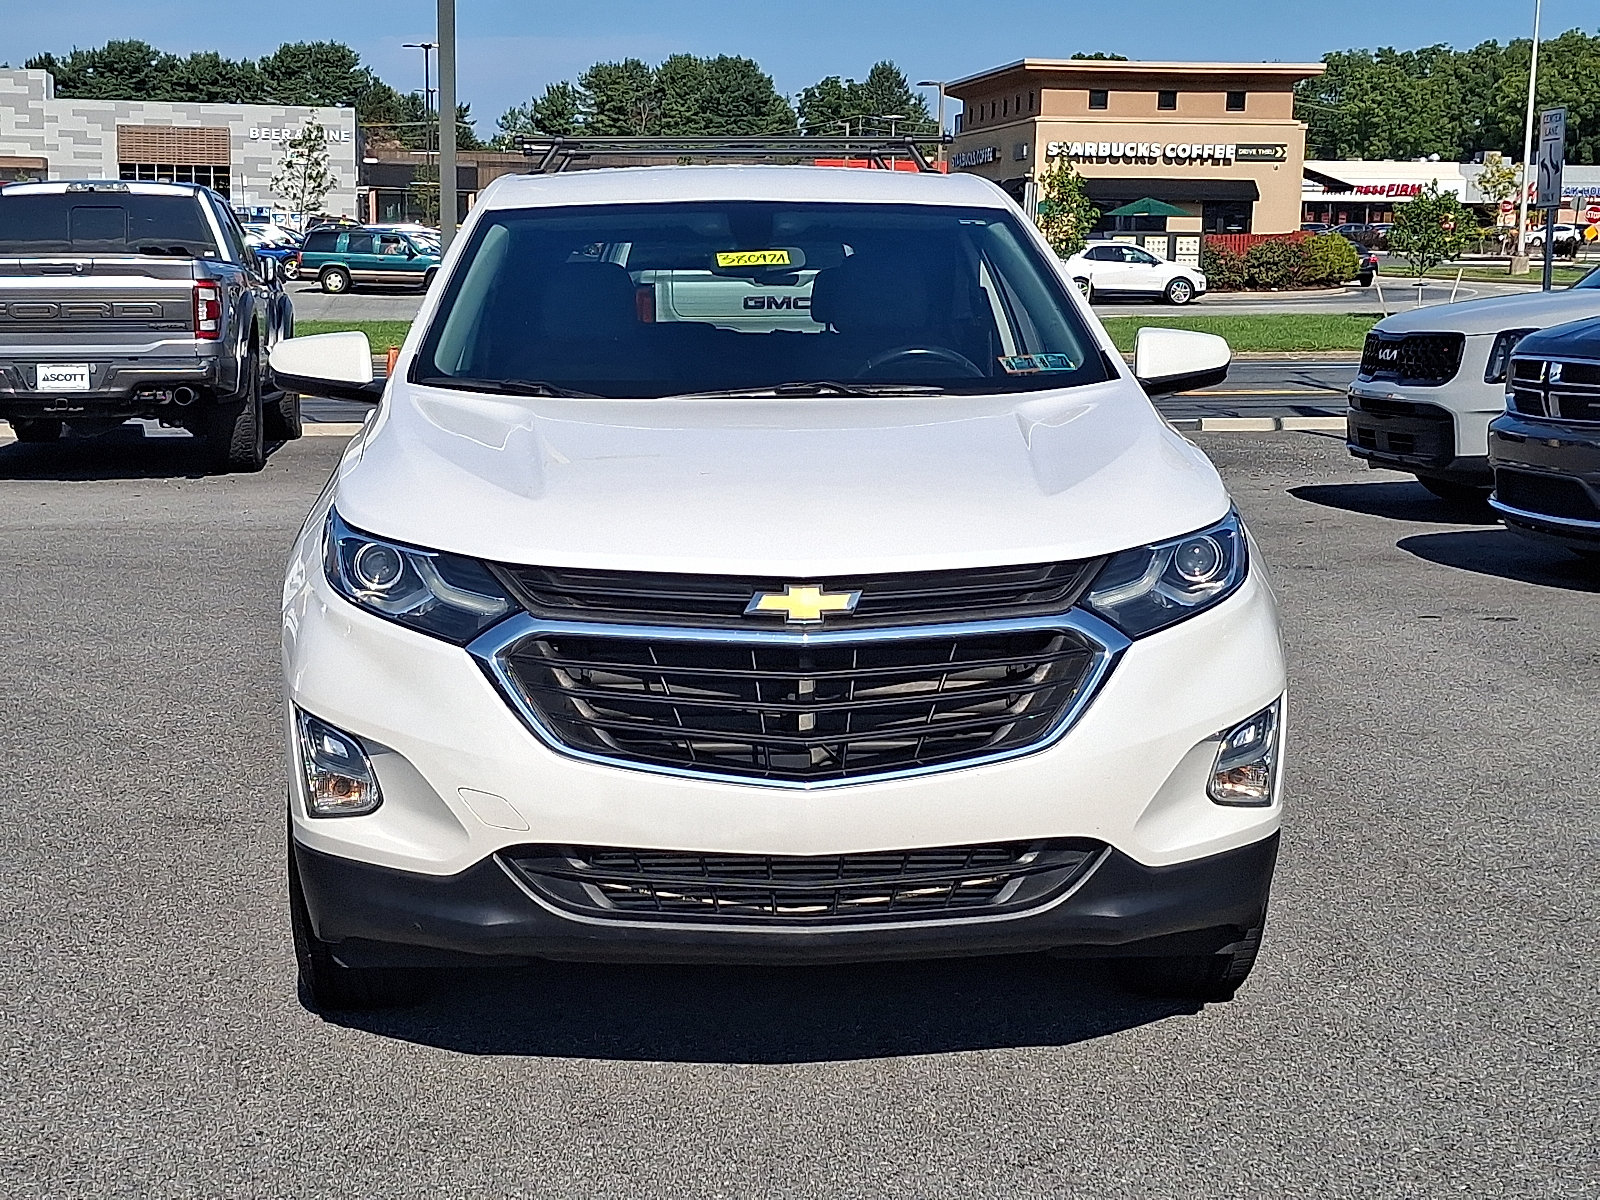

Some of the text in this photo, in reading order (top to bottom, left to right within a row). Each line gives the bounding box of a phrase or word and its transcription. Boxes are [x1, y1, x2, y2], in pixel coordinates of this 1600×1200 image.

[249, 127, 291, 141] BEER
[1047, 141, 1161, 158] STARBUCKS
[1164, 143, 1236, 159] COFFEE
[1386, 183, 1422, 198] FIRM
[0, 302, 163, 319] ORD
[743, 296, 811, 310] GMC
